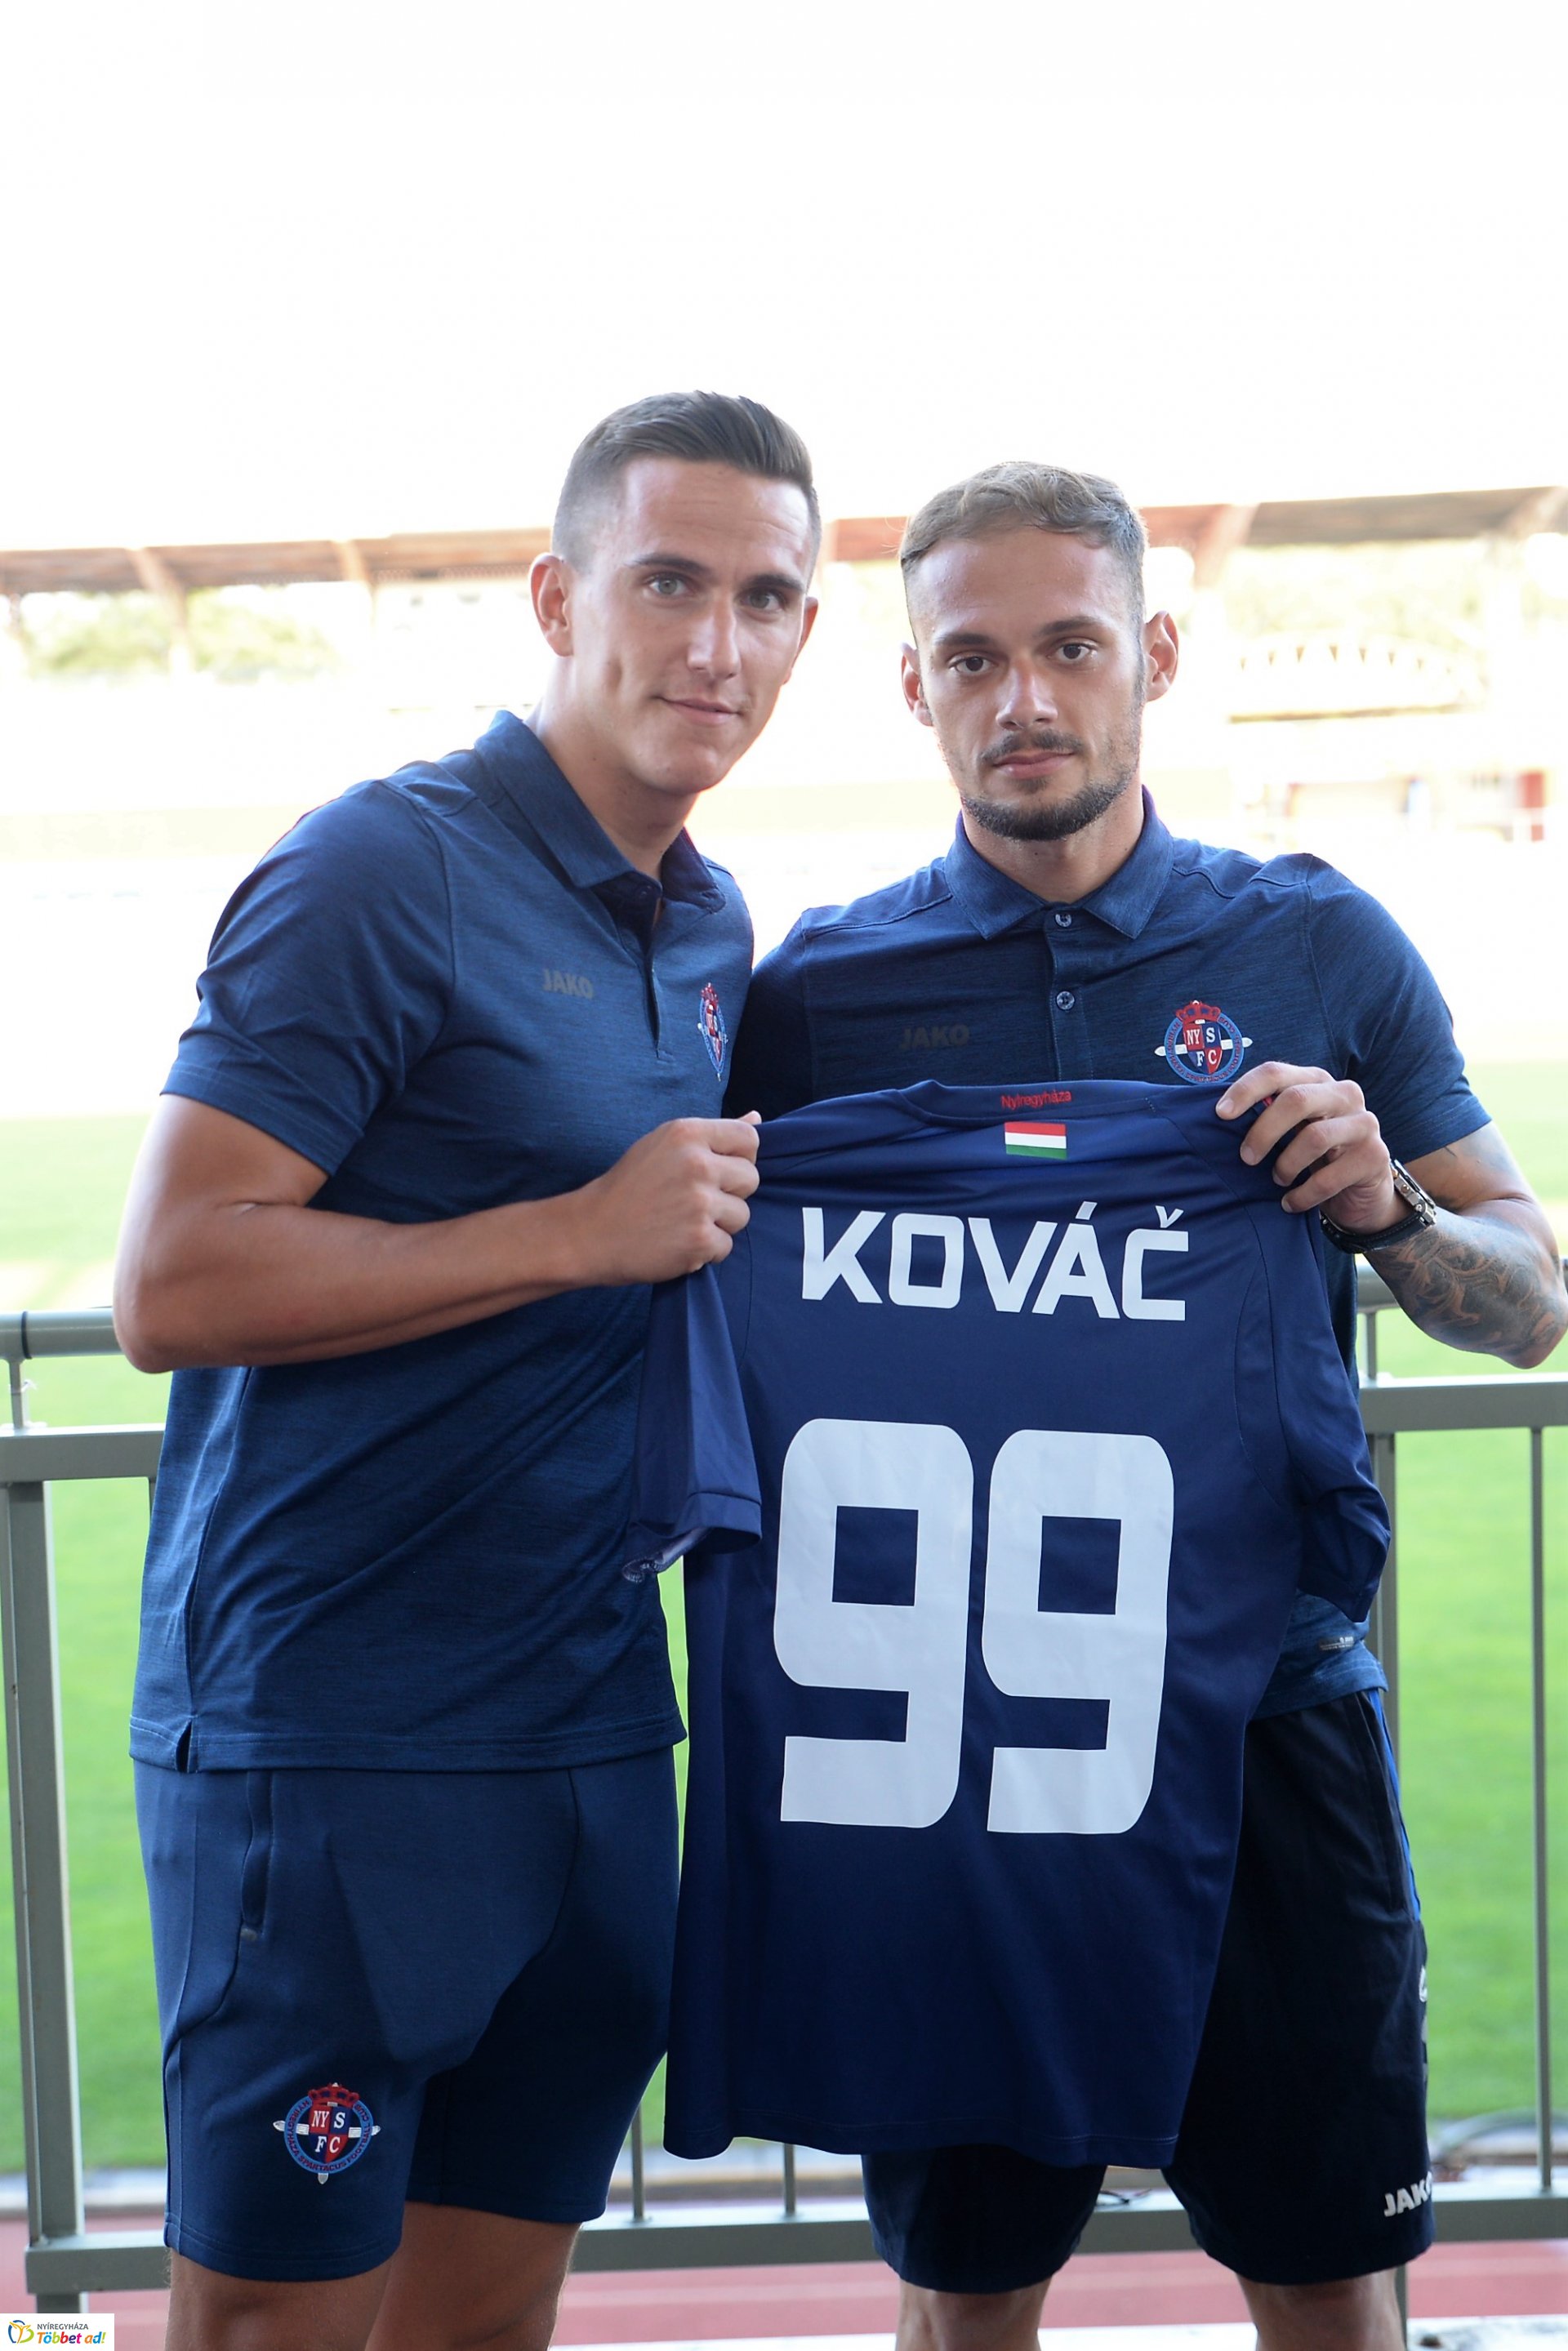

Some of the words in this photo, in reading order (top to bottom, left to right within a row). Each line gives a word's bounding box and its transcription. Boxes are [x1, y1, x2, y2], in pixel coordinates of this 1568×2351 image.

[542, 968, 595, 999] JAKO
[901, 1023, 970, 1050] JAKO
[1187, 1029, 1200, 1045] NY
[1205, 1027, 1216, 1043] S
[1196, 1051, 1205, 1066] F
[1208, 1049, 1217, 1065] C
[801, 1201, 1189, 1321] KOVÁČ
[773, 1418, 1174, 1834] 99
[311, 2110, 330, 2127] NY
[333, 2112, 346, 2129] S
[315, 2135, 327, 2153] F
[329, 2136, 341, 2153] C
